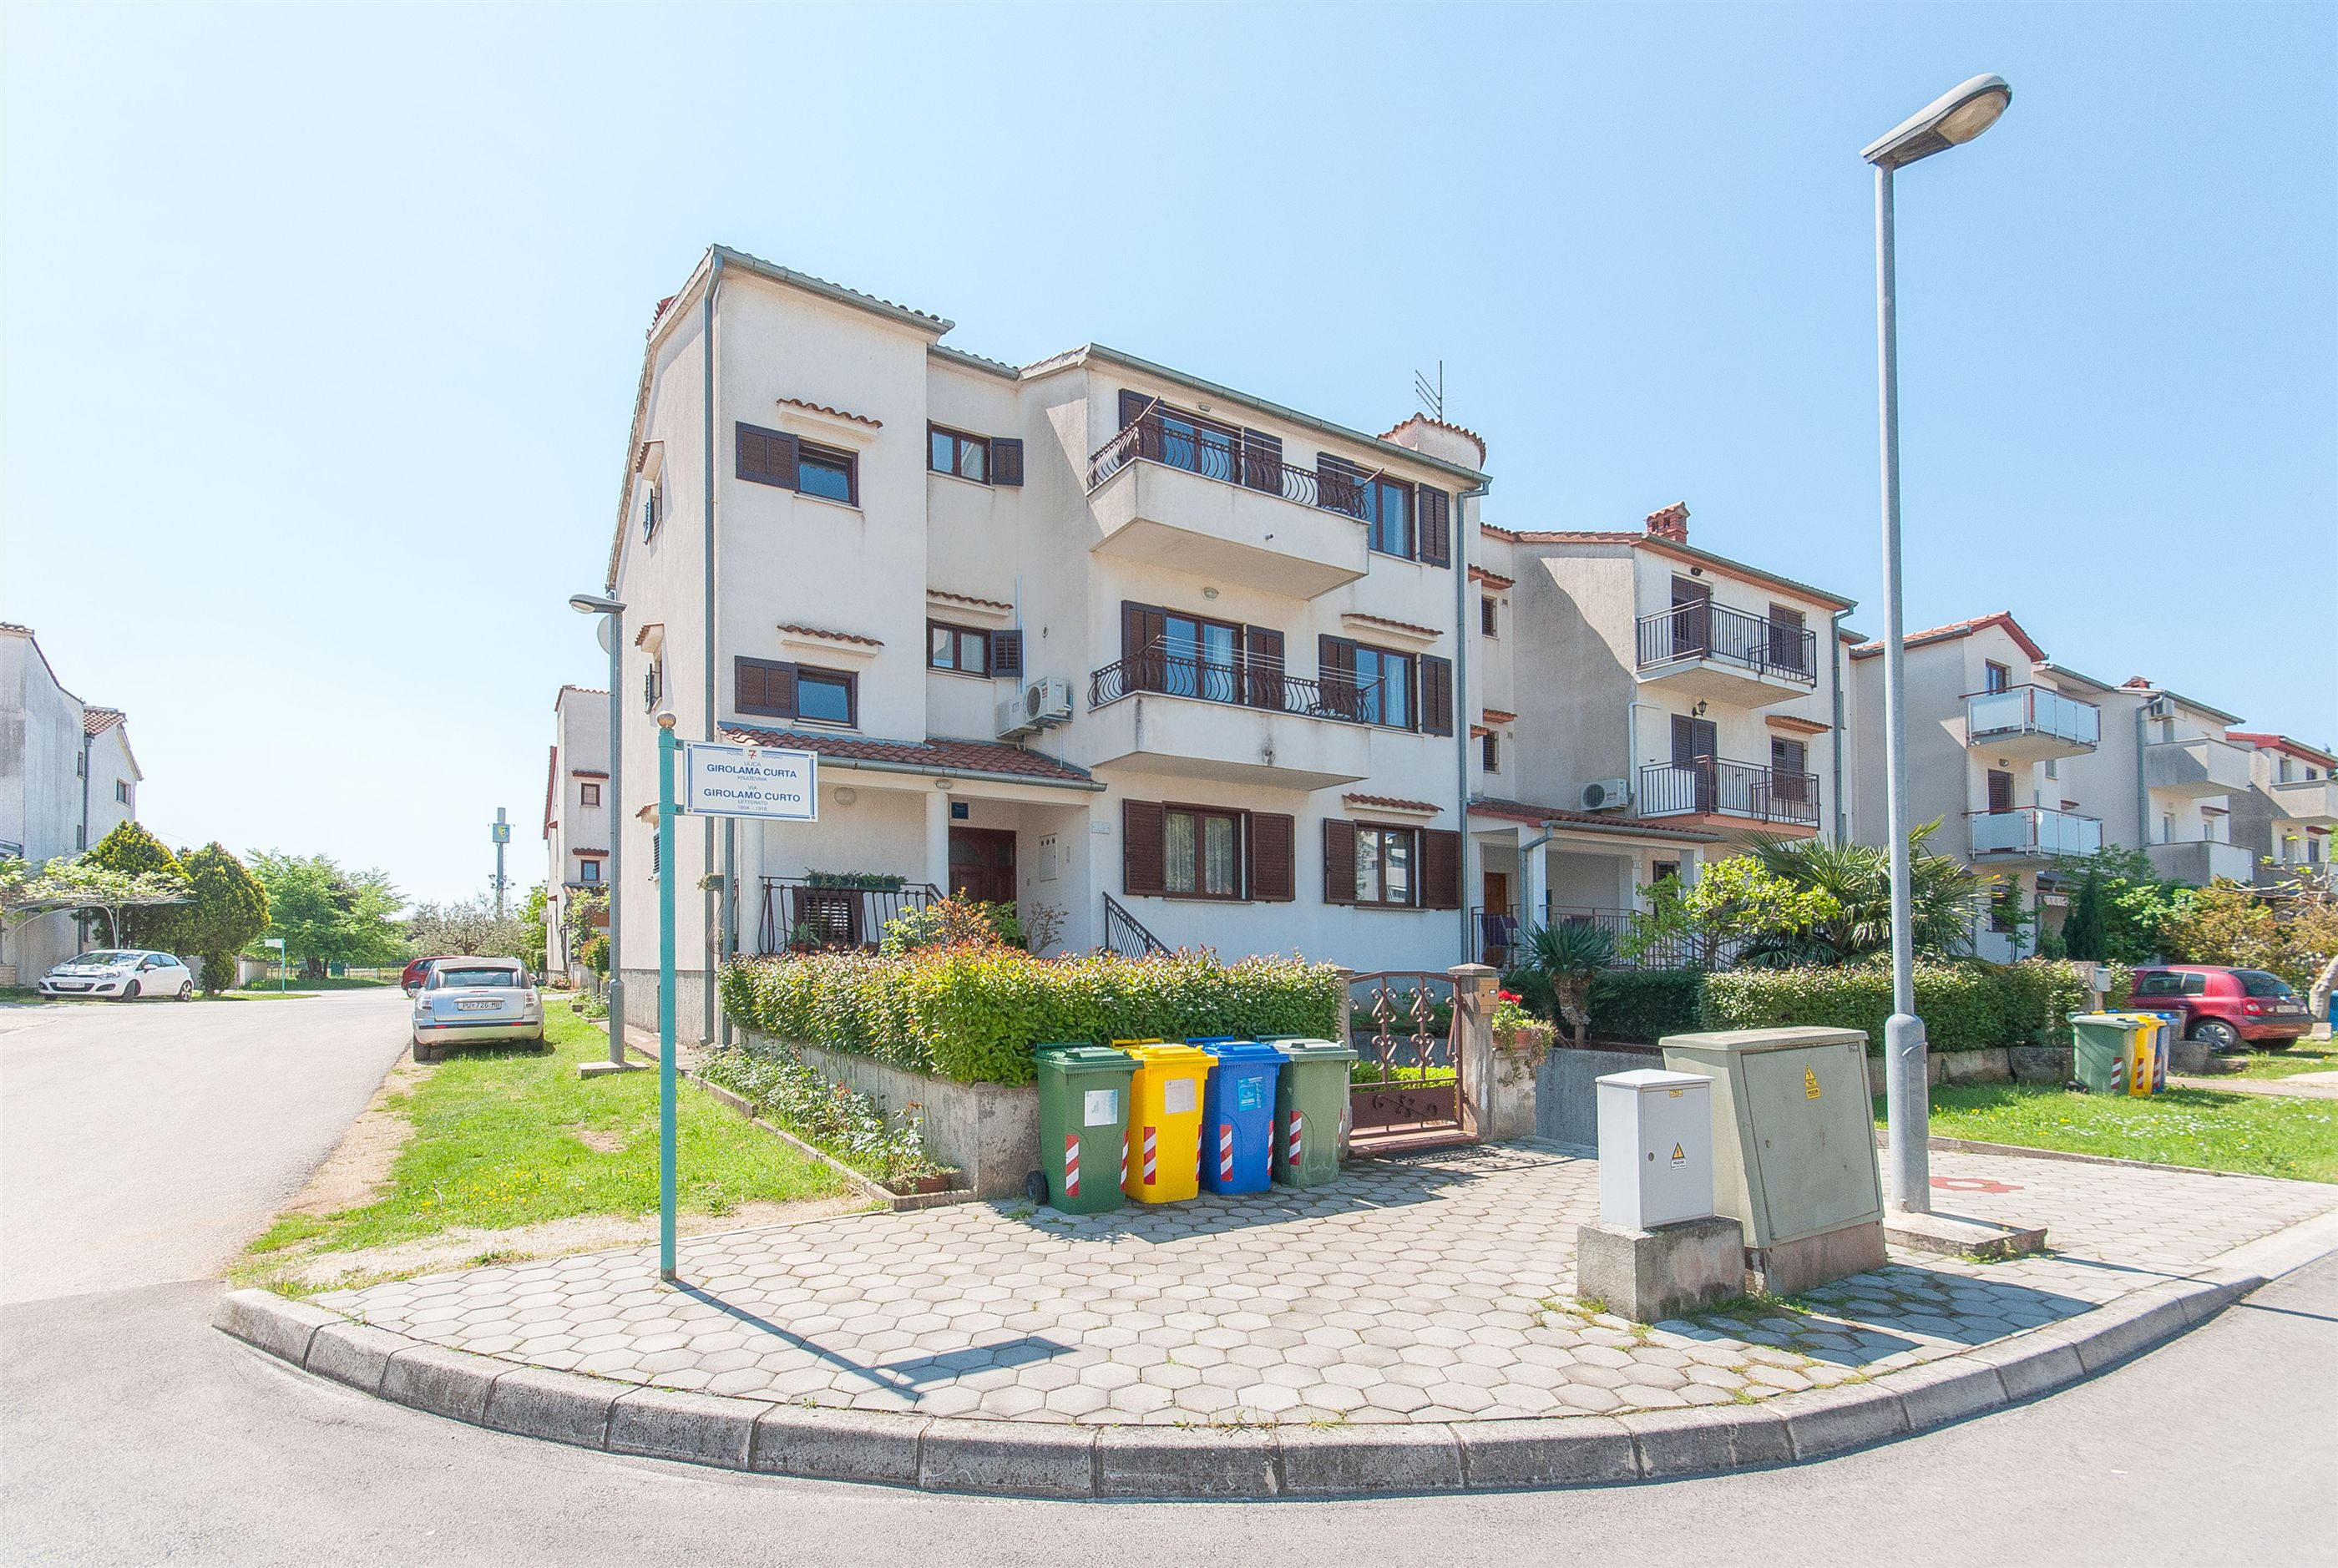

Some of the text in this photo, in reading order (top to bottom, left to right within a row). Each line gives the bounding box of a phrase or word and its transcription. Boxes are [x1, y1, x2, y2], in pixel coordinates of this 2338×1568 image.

[706, 763, 797, 778] GIROLAMA CURTA
[703, 788, 801, 802] GIROLAMO CURTO
